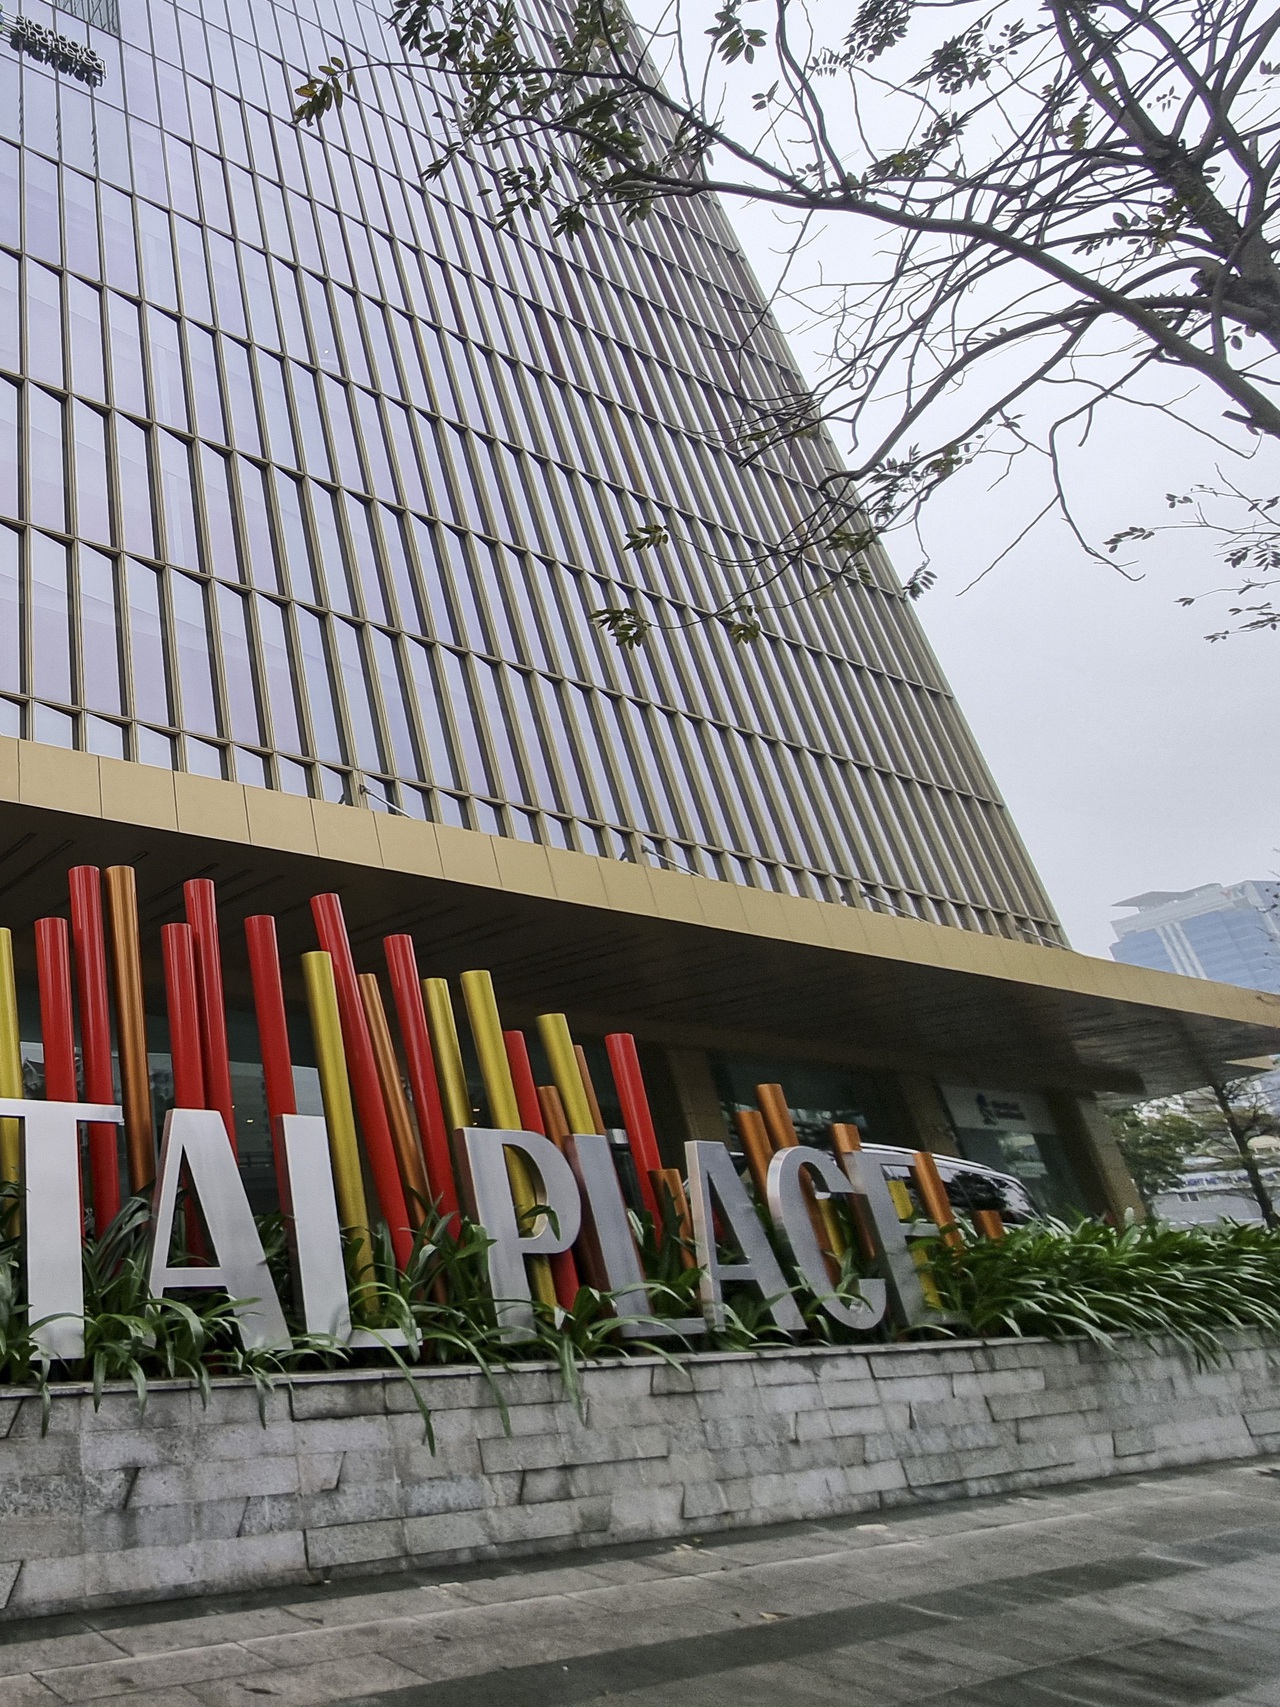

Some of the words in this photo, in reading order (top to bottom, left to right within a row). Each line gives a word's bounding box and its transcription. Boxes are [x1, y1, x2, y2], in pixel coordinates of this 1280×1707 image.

[16, 15, 98, 60] standard
[17, 25, 104, 71] chartered
[457, 1126, 970, 1343] PLACE
